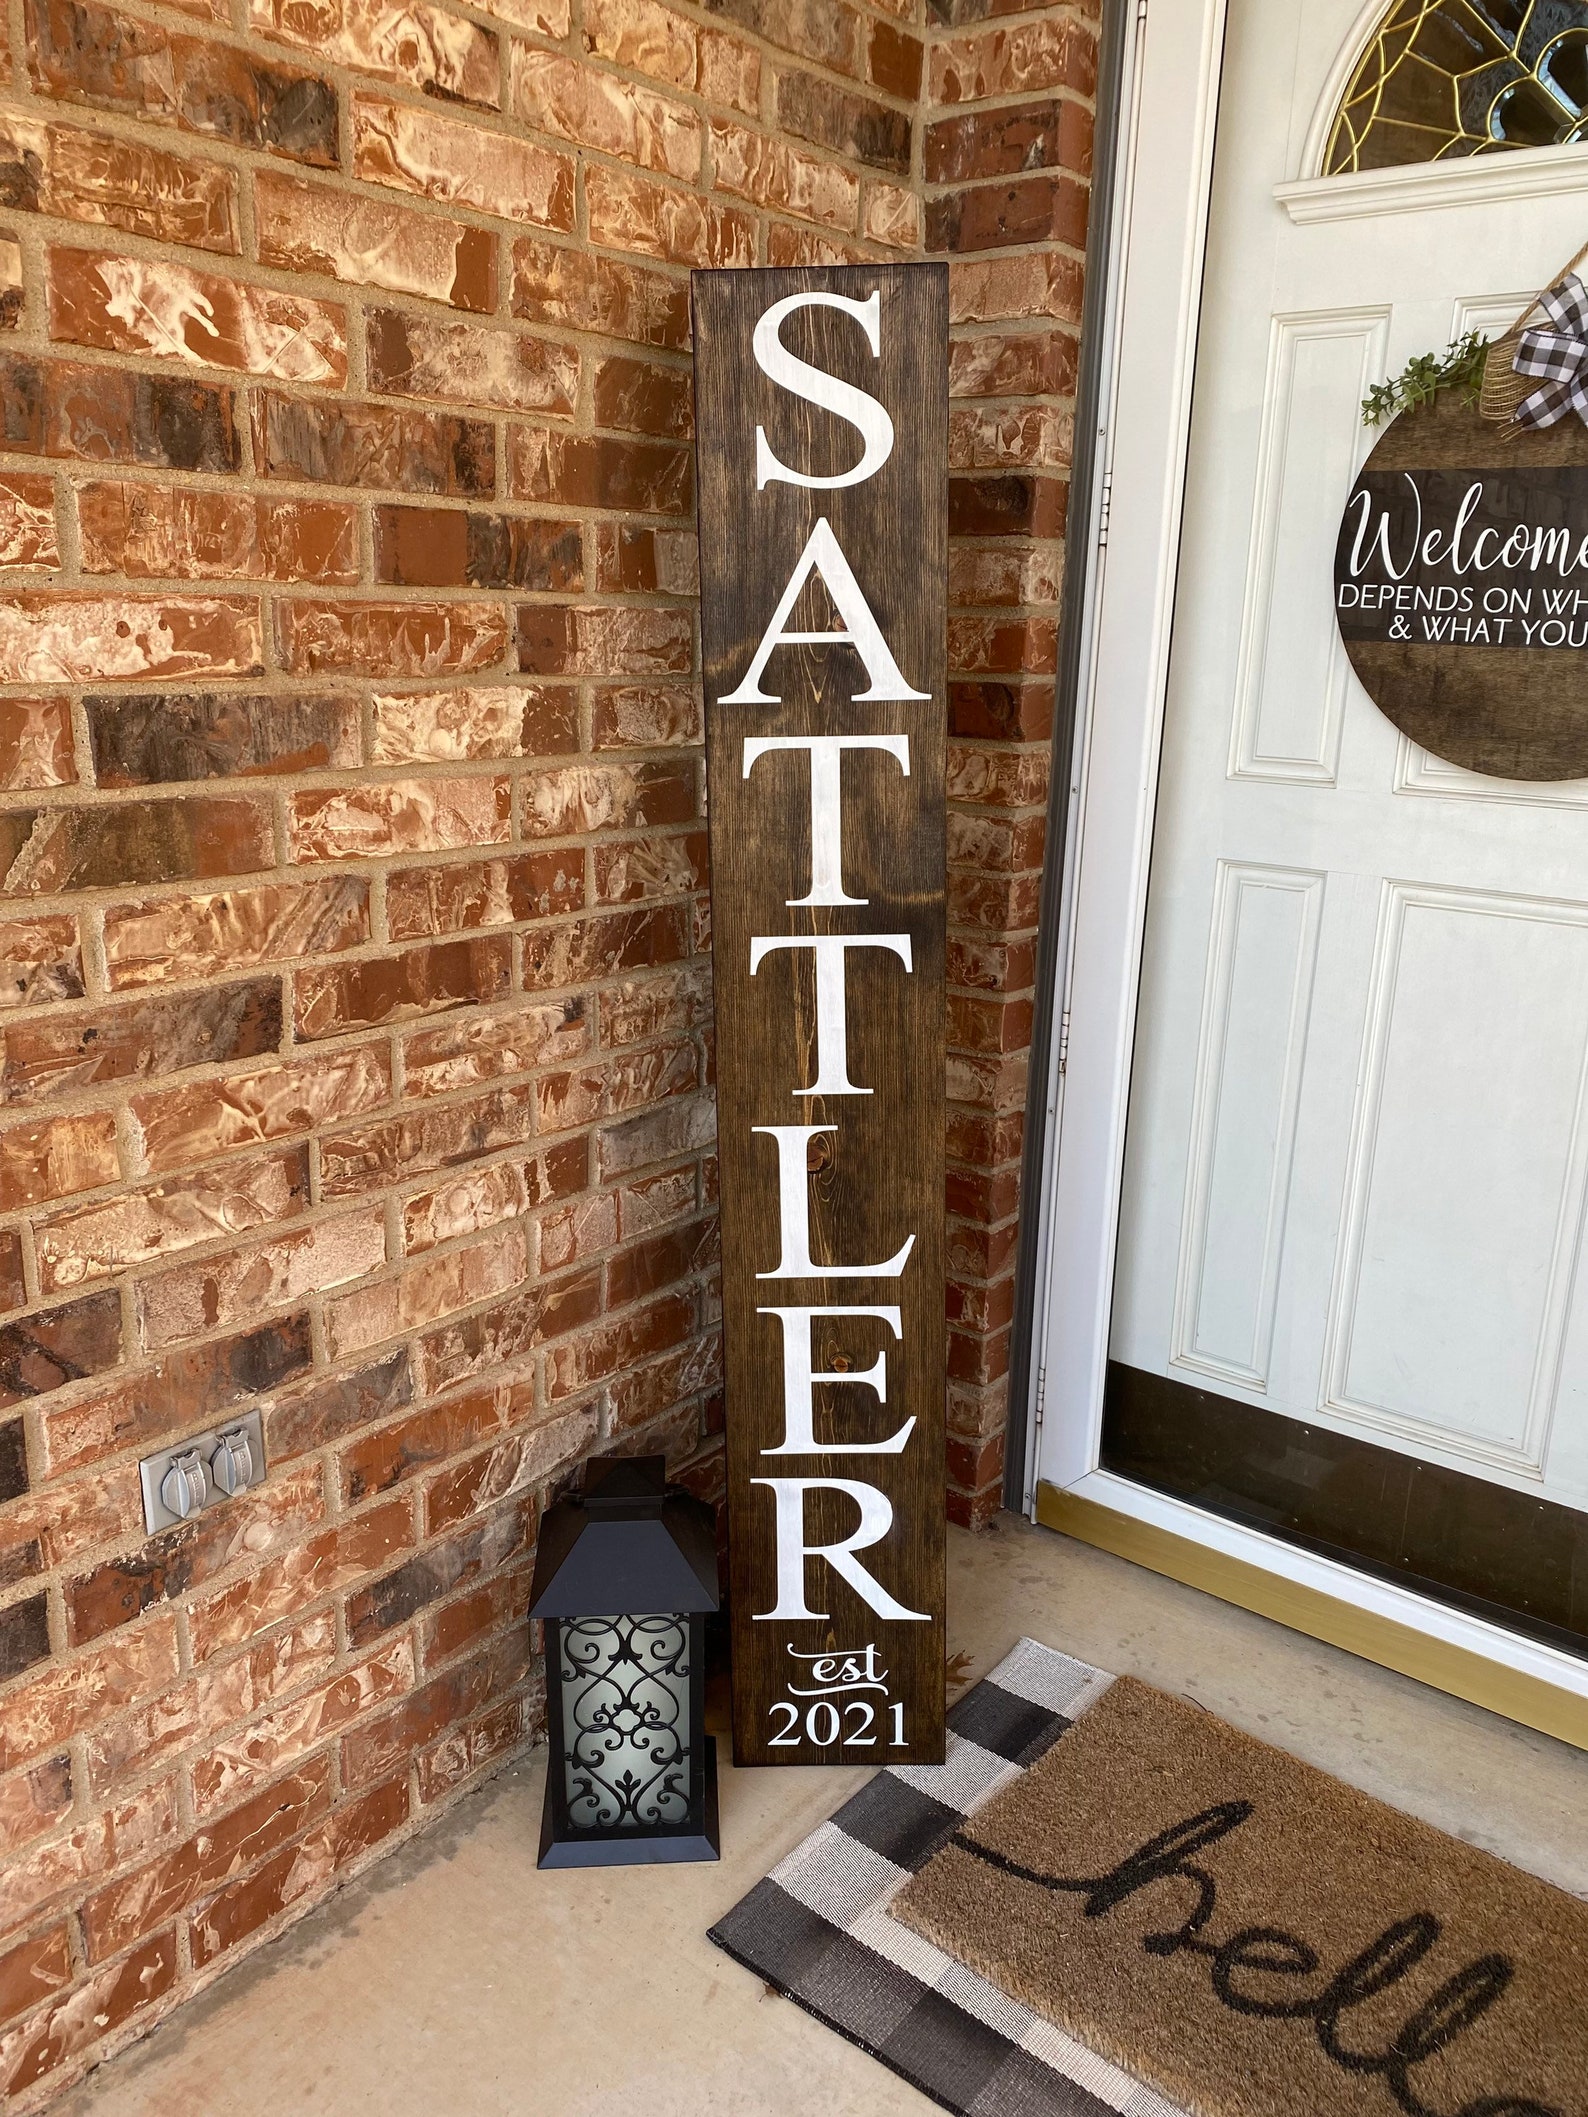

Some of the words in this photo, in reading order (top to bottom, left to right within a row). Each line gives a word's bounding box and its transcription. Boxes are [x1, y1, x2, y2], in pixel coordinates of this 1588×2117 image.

[1338, 583, 1474, 612] DEPENDS
[1483, 587, 1532, 614] ON
[1388, 614, 1413, 640] &
[1422, 615, 1513, 644] WHAT
[1521, 619, 1588, 648] YOU
[716, 289, 933, 1621] SATTLER
[787, 1643, 889, 1683] est
[767, 1702, 910, 1746] 2021
[951, 1799, 1565, 2117] hell
